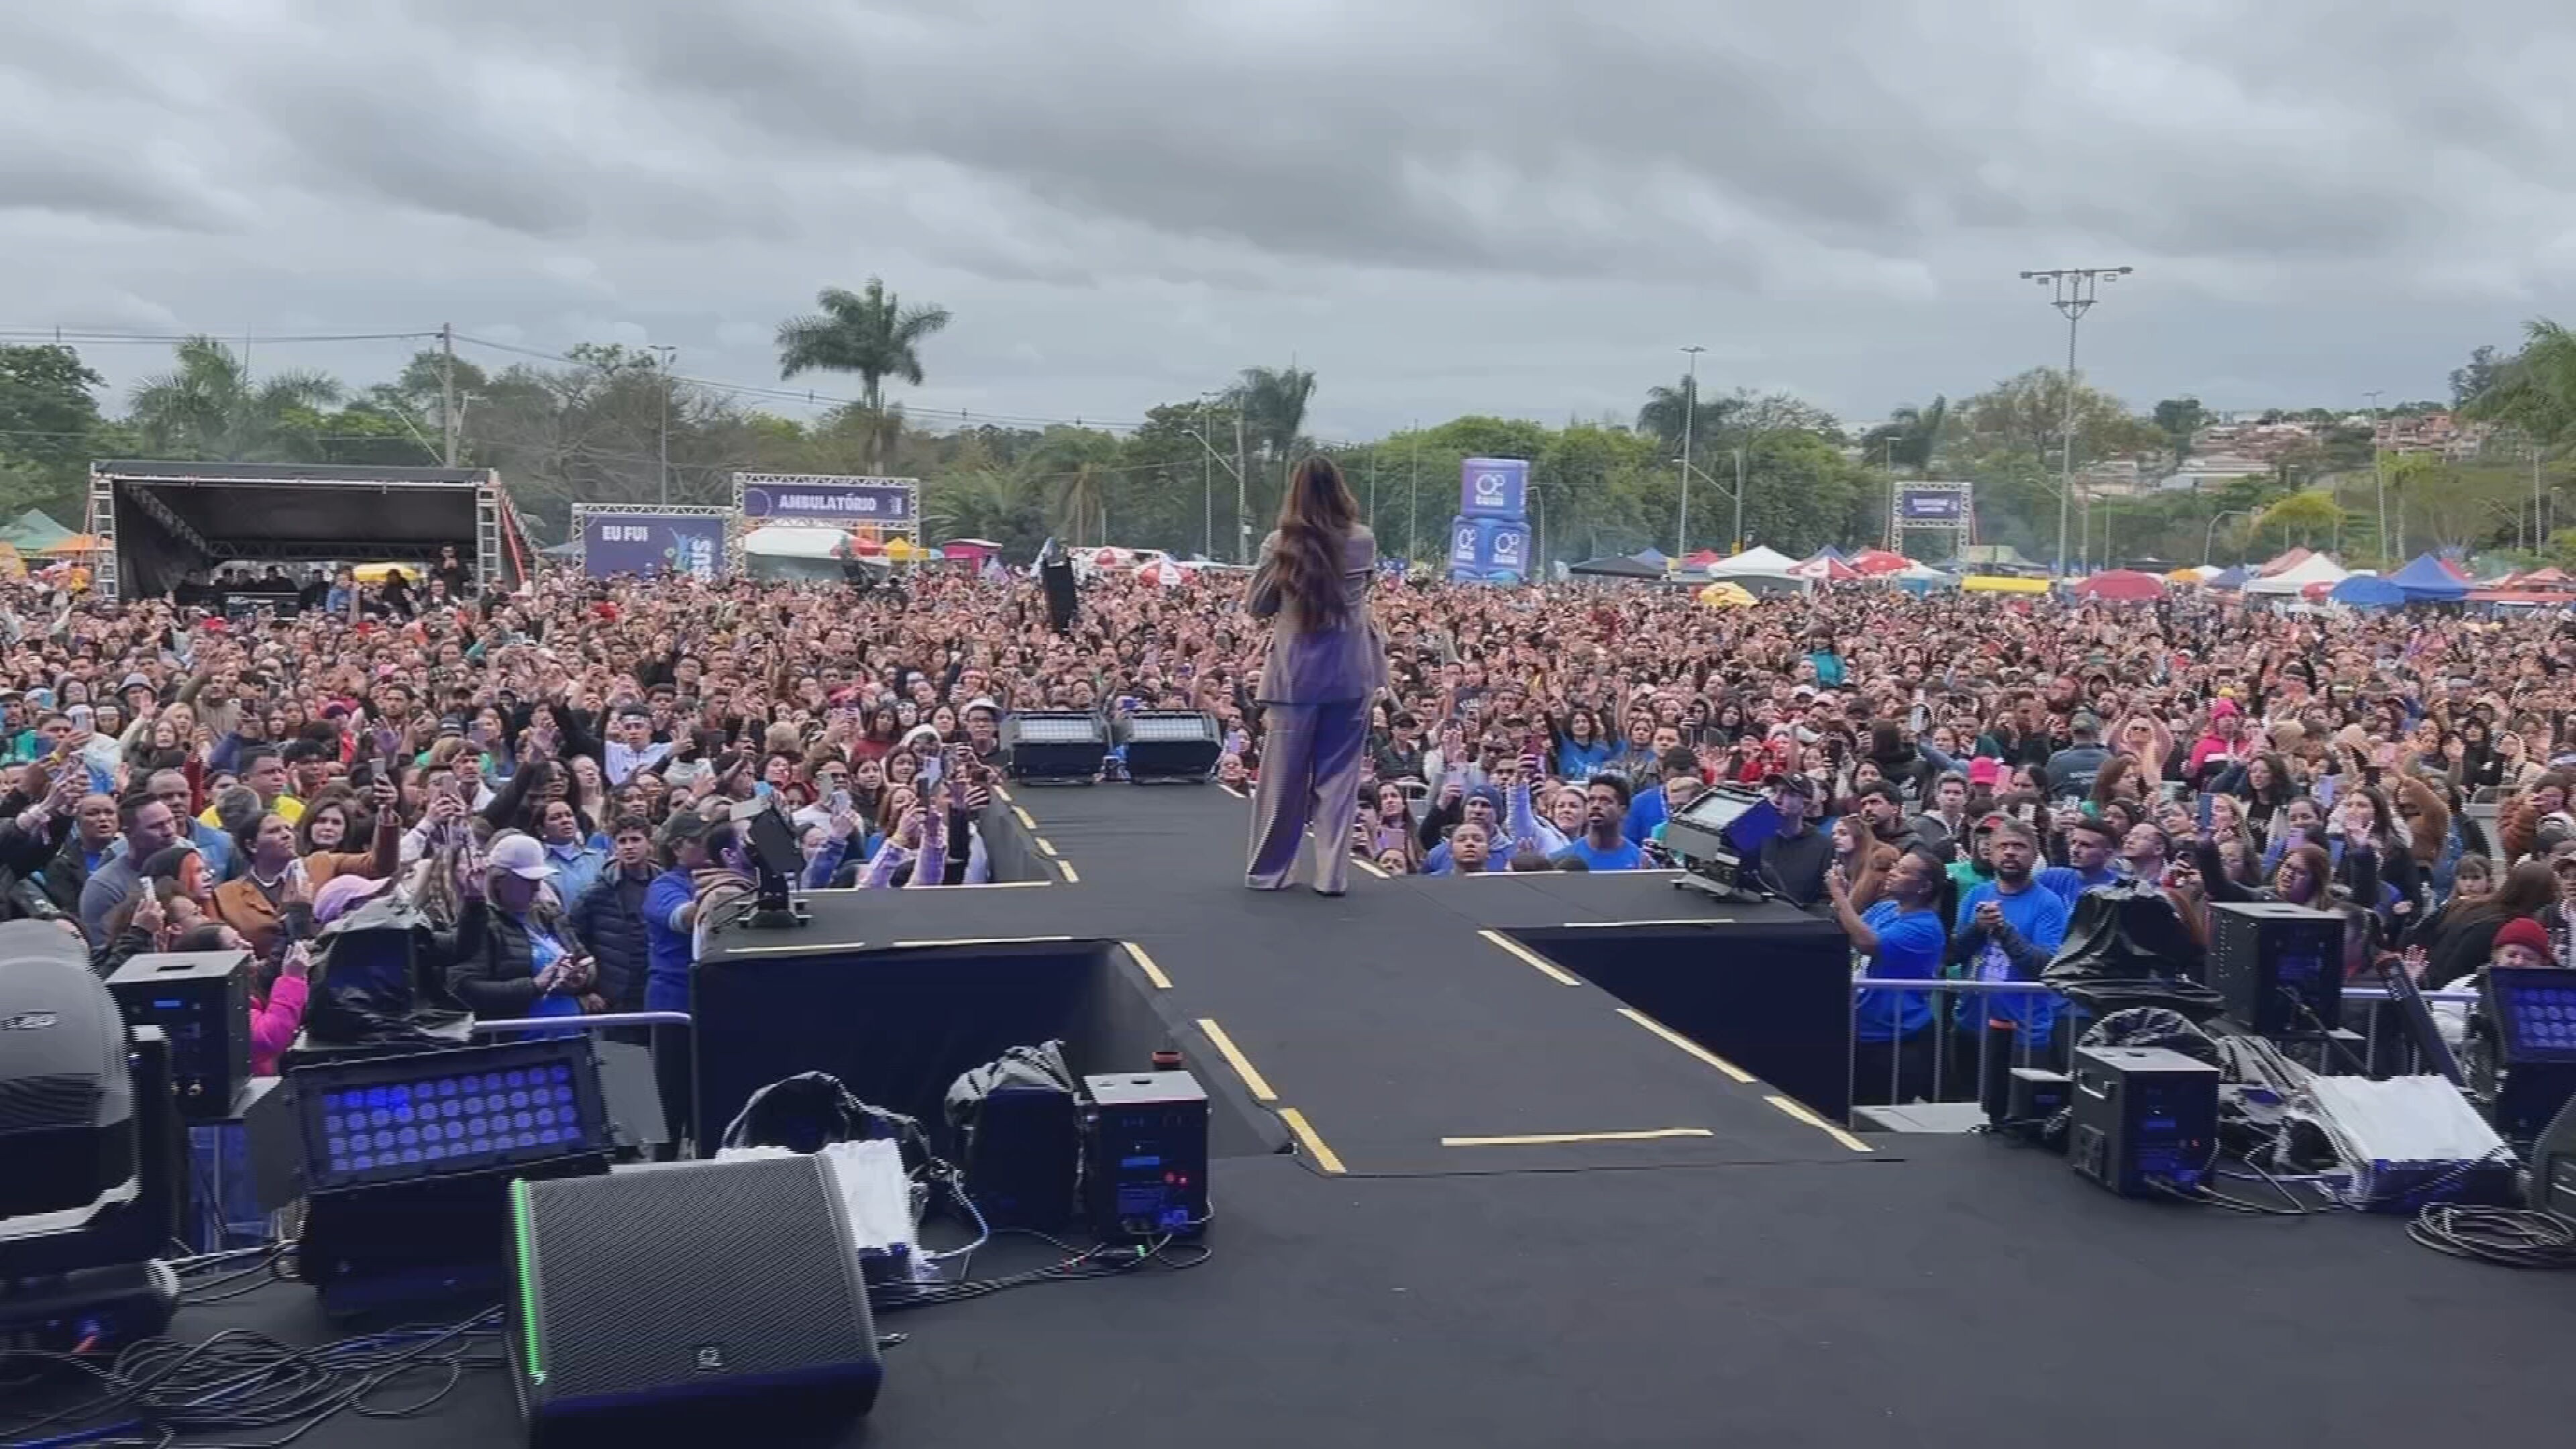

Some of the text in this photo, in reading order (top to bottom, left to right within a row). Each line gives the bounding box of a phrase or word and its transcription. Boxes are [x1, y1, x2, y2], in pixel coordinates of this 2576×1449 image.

[779, 493, 877, 512] AMBULATÓRIO
[602, 525, 649, 542] EU FUI
